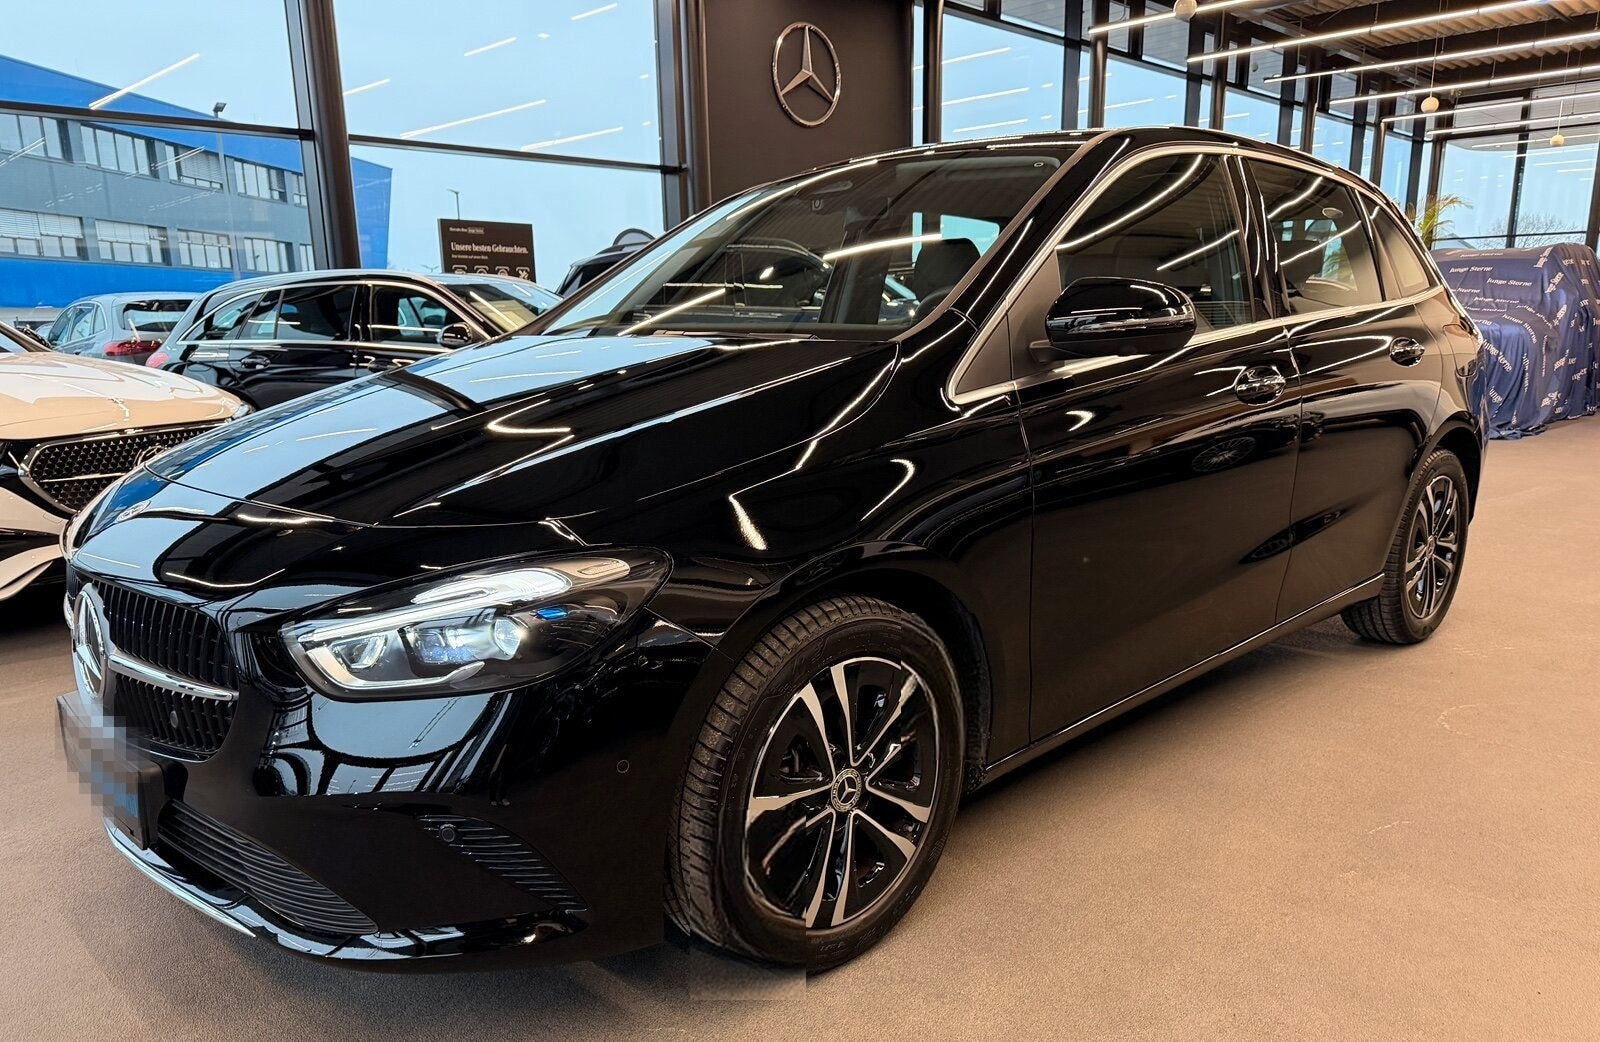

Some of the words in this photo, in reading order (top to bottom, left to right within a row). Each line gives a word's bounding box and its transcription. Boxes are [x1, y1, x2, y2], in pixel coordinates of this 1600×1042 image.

[451, 242, 472, 251] Unsere
[472, 243, 491, 252] besten
[492, 244, 528, 254] Gebrauchten.
[1486, 277, 1507, 285] Junge
